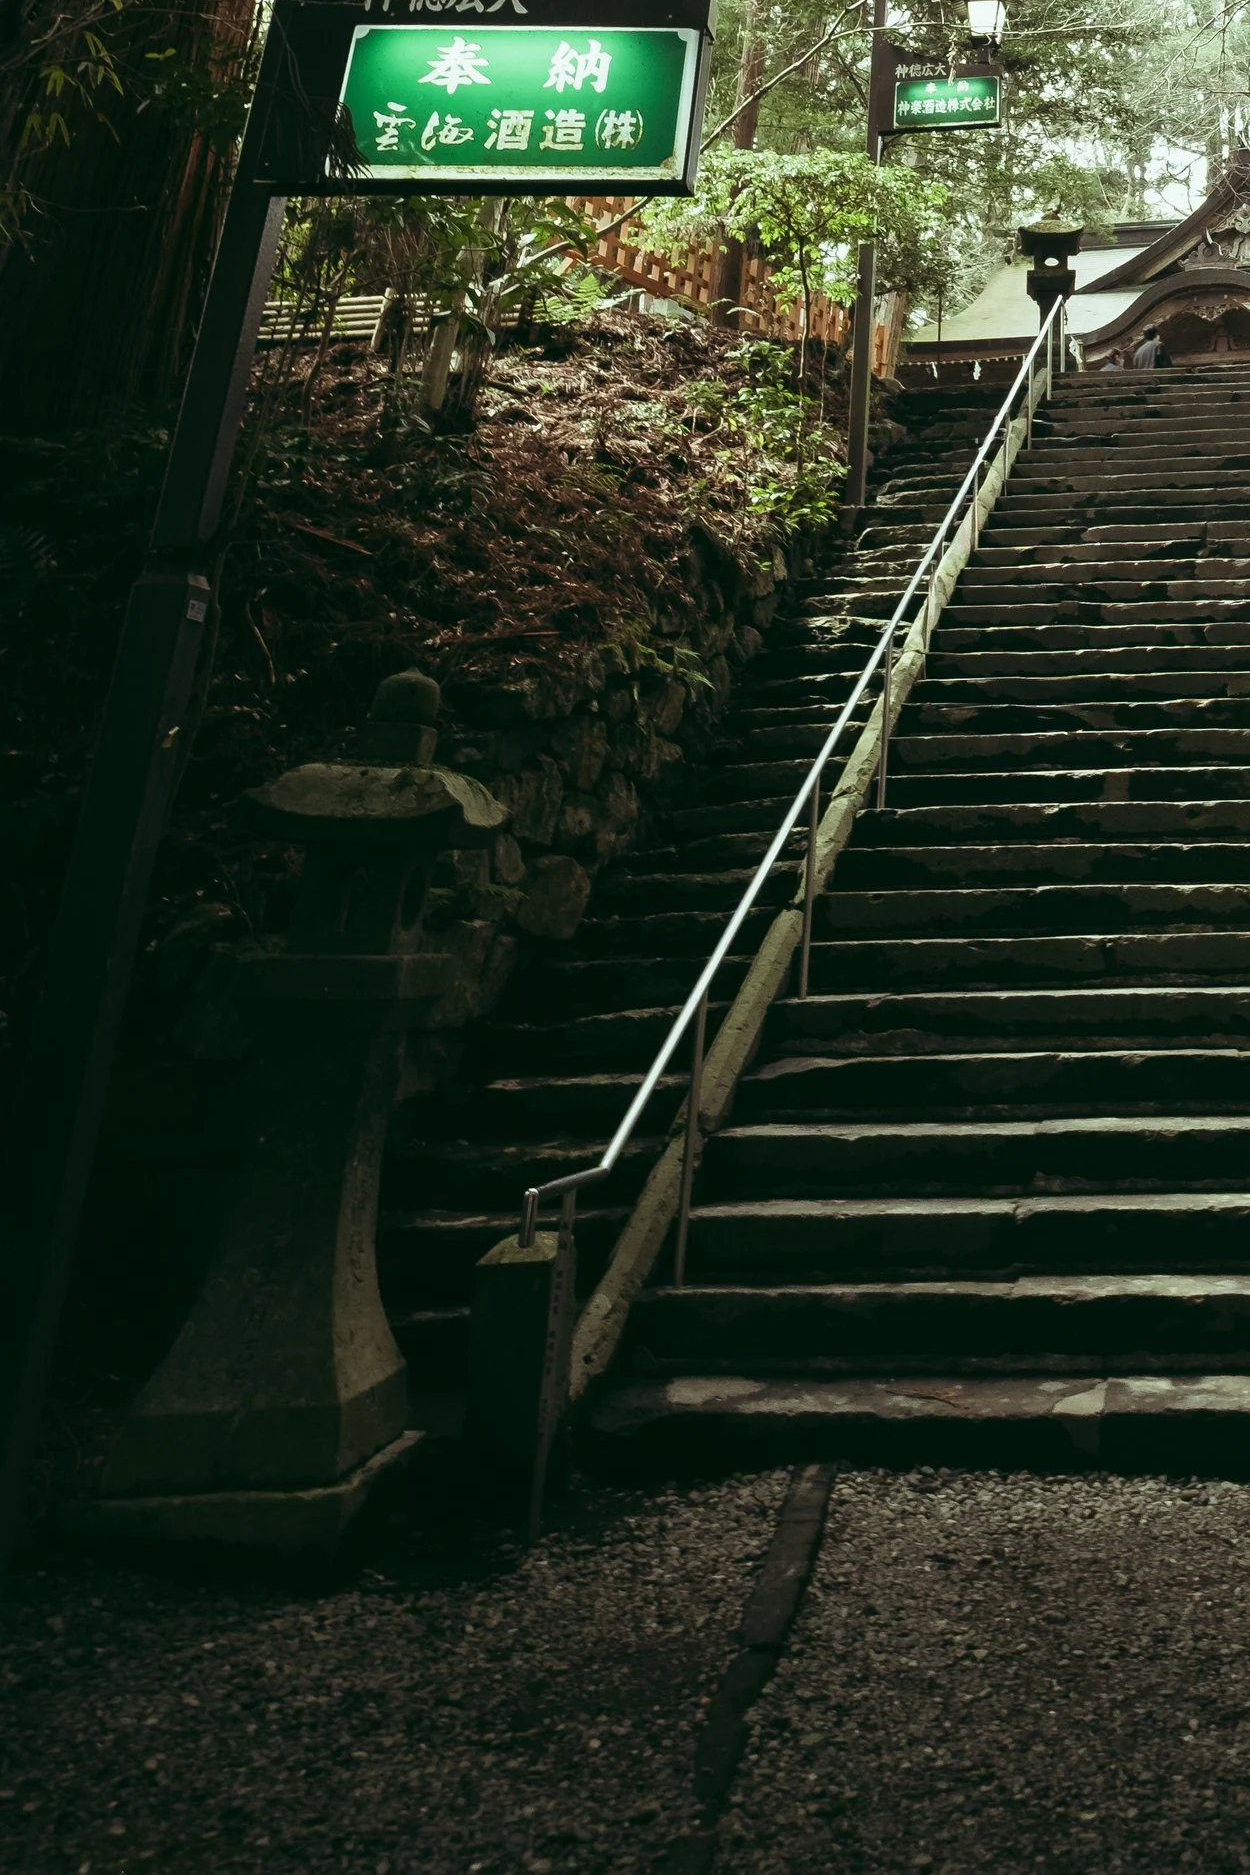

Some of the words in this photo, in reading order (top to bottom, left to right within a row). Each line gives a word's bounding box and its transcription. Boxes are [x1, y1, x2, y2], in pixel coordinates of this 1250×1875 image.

[417, 36, 612, 95] 奉納
[895, 62, 947, 79] 神徳広大
[925, 81, 970, 94] 奉納
[897, 96, 996, 117] 神楽酒造株式会社
